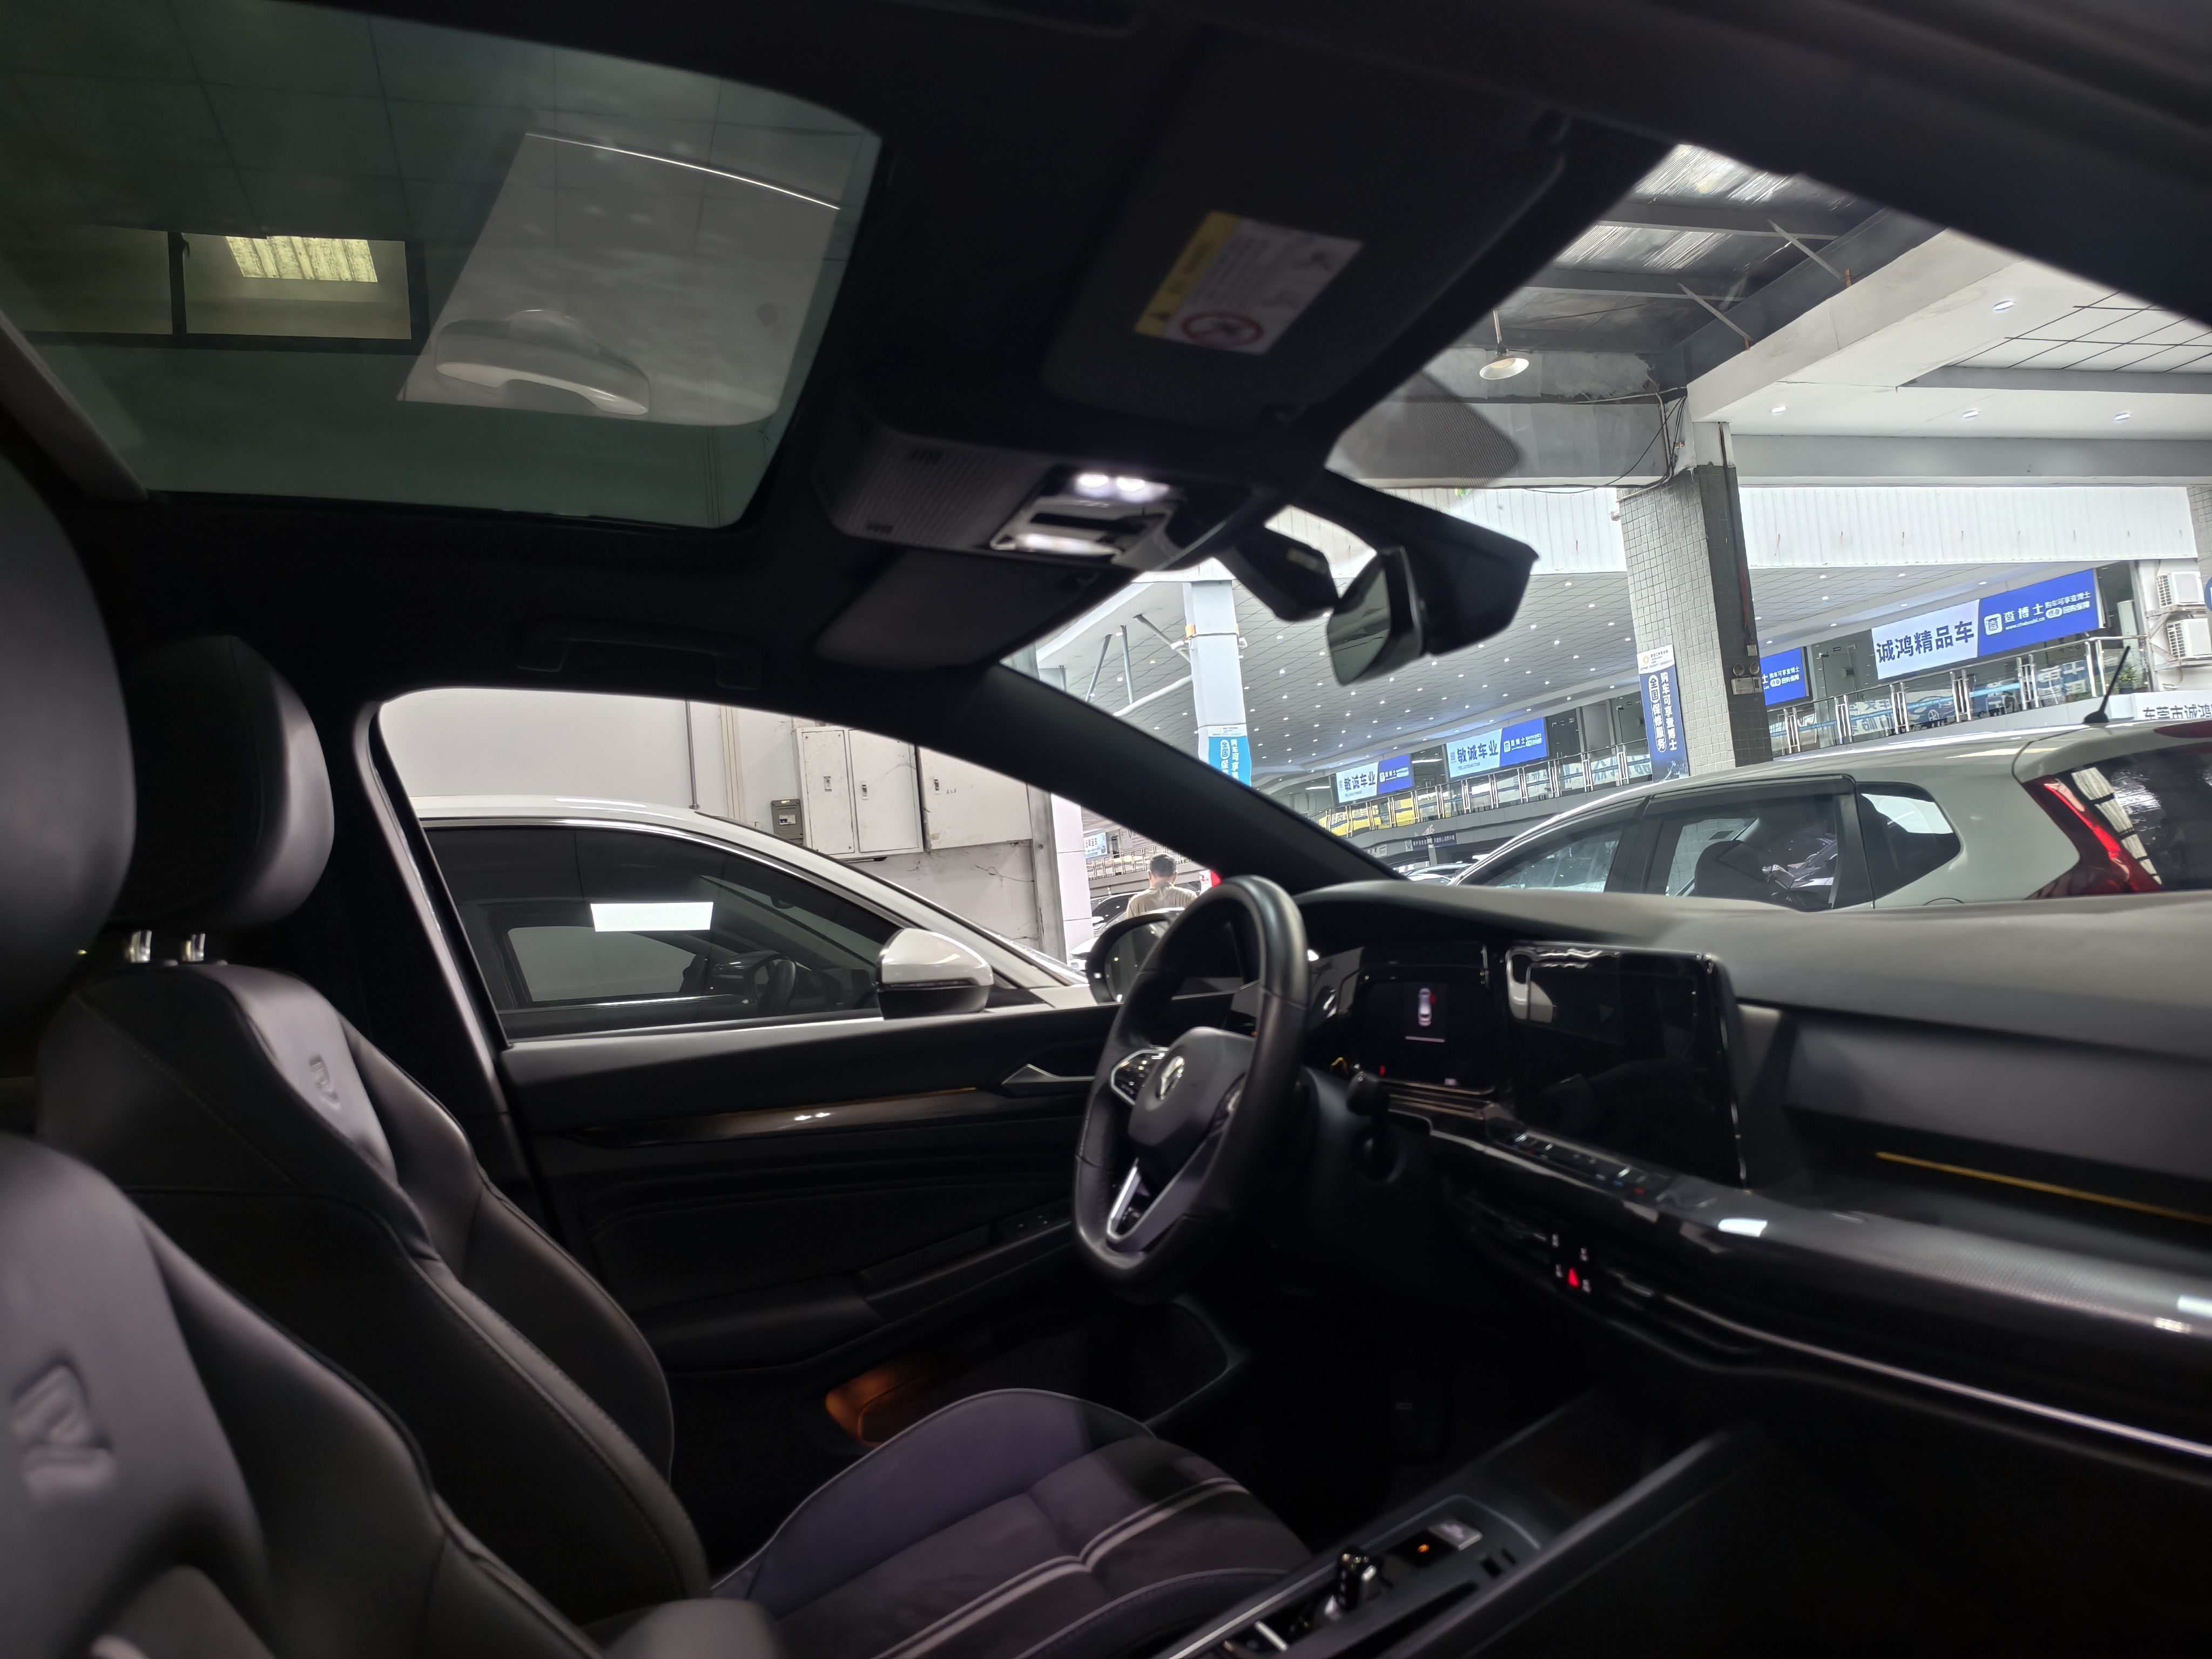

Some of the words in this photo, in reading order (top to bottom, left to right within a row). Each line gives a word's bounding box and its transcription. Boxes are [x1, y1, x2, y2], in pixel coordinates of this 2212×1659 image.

[2004, 603, 2044, 623] 查博士
[1876, 621, 1974, 663] 诚鸿精品车
[1649, 677, 1666, 751] 全国保修服务
[1660, 671, 1677, 751] 购车可享查博士
[2143, 704, 2212, 720] 东莞市诚鸿
[1457, 740, 1499, 764] 敏诚车业
